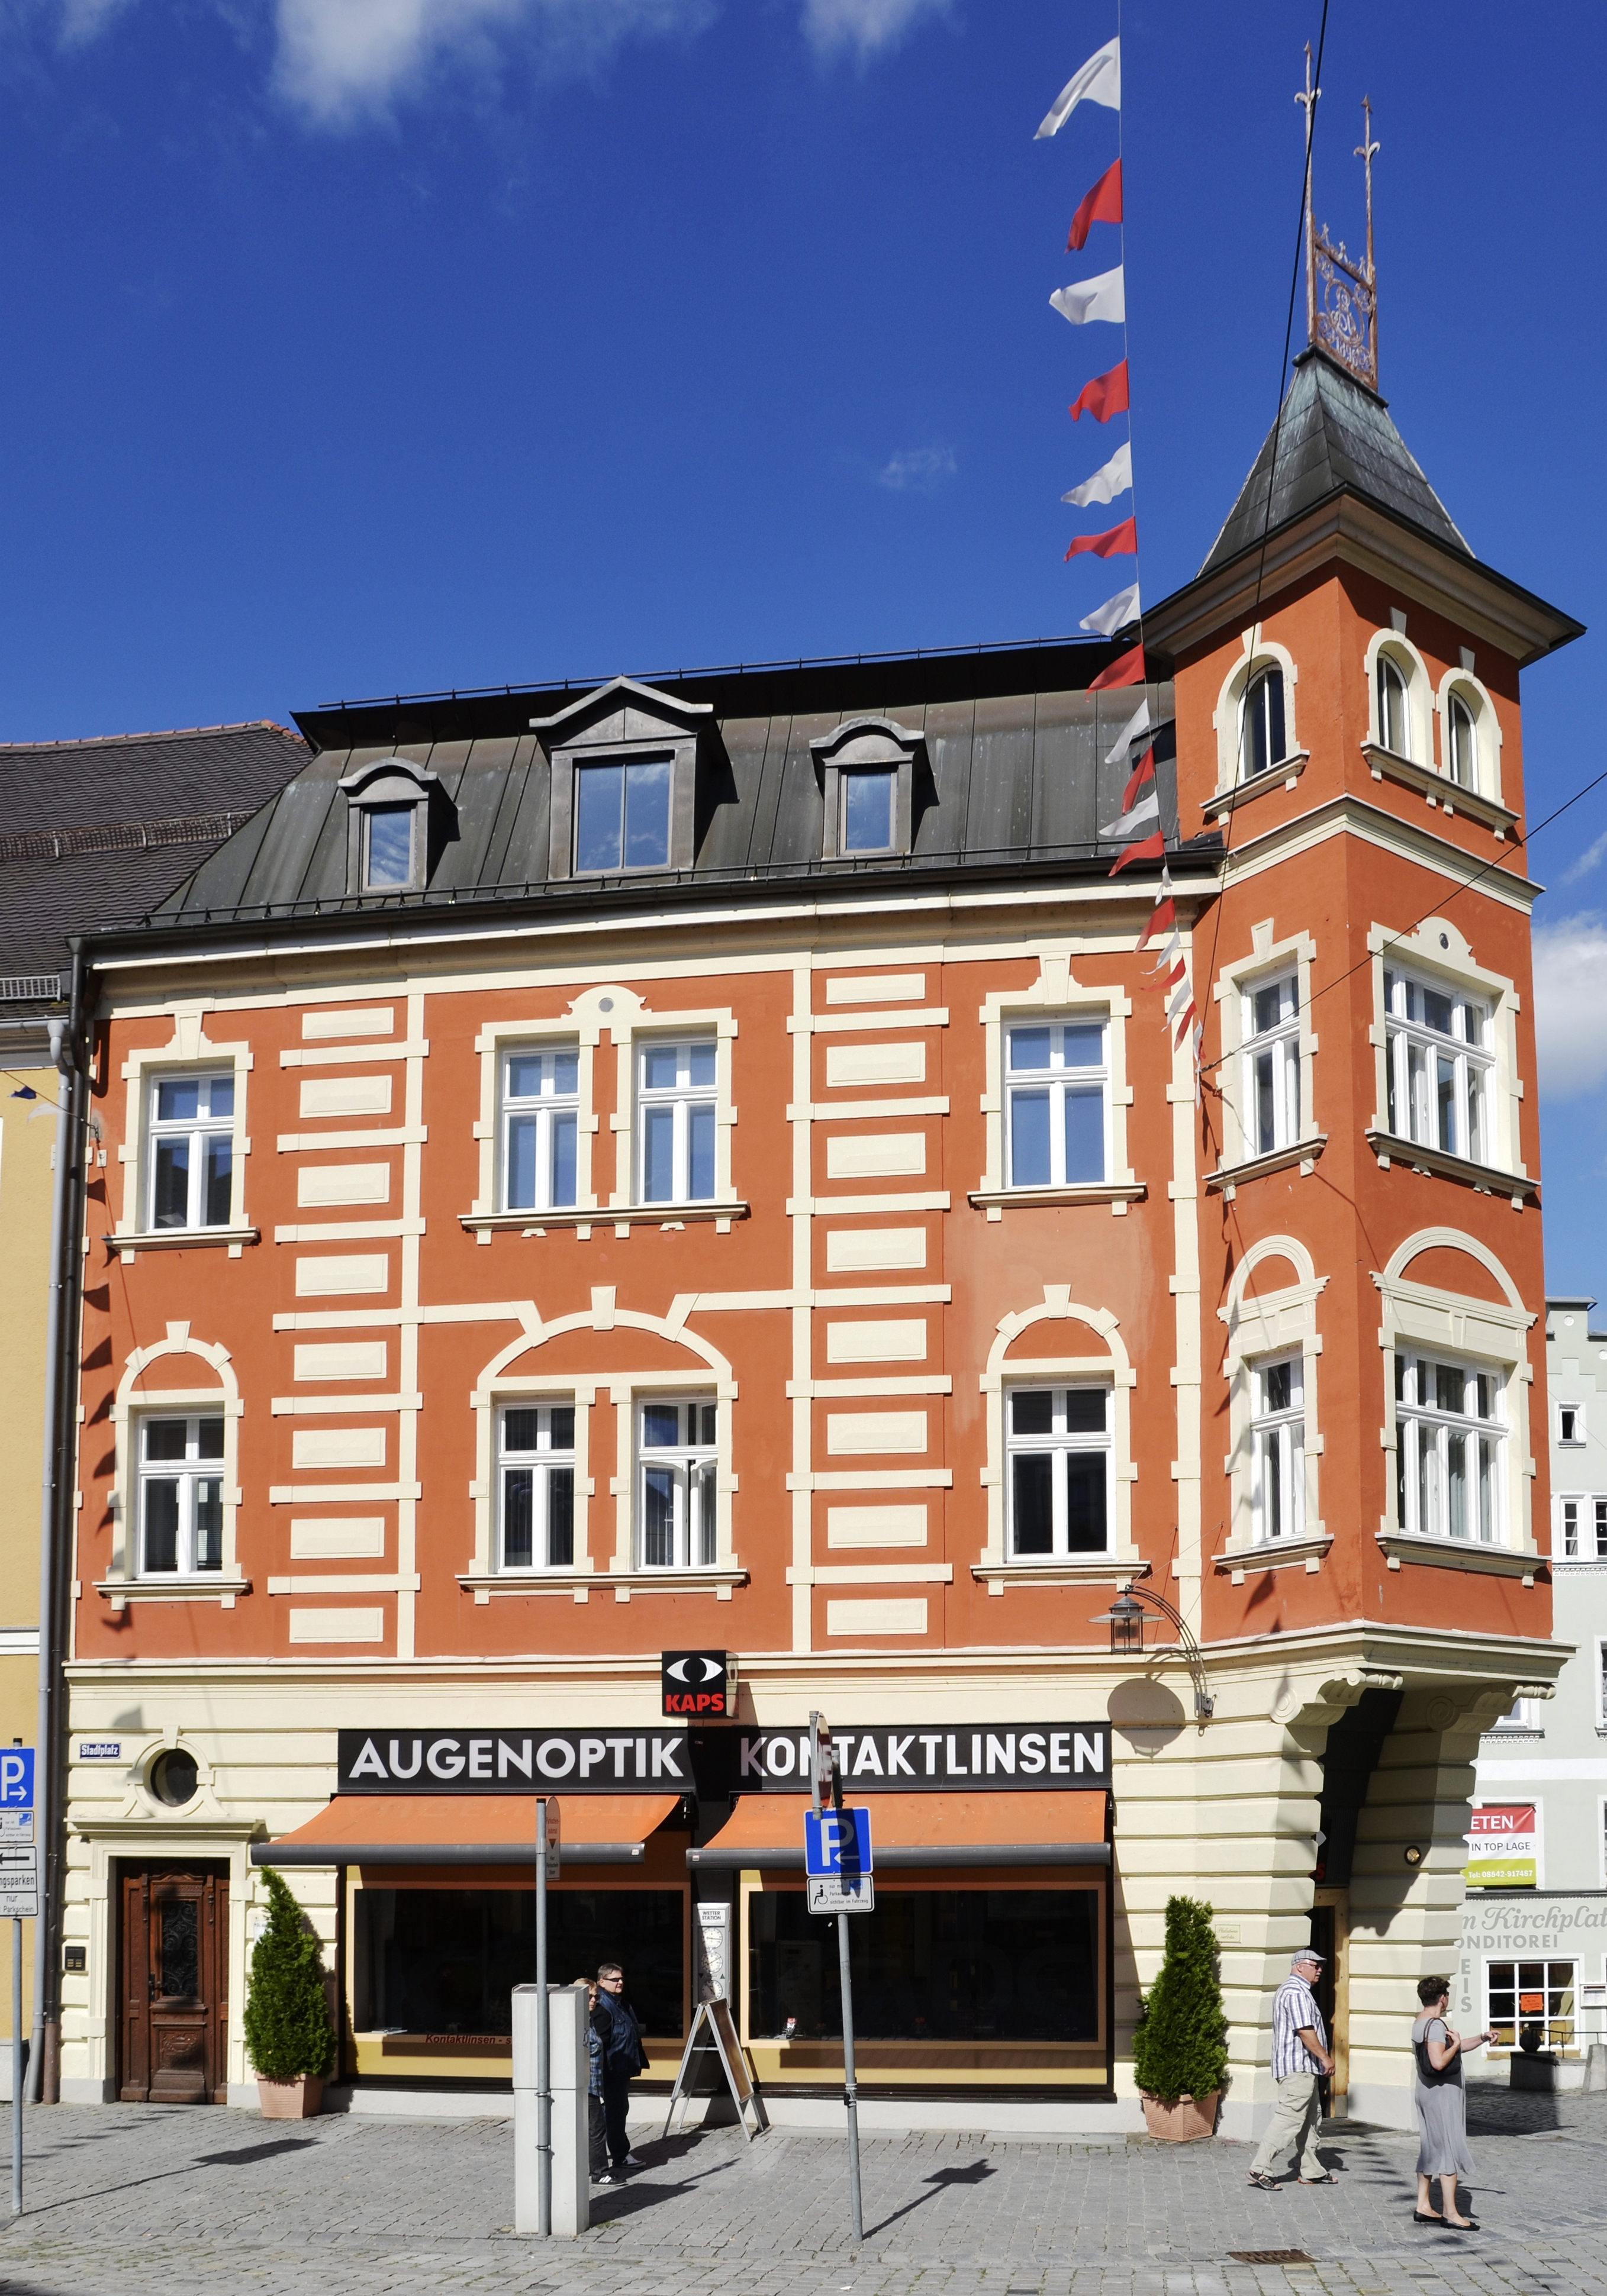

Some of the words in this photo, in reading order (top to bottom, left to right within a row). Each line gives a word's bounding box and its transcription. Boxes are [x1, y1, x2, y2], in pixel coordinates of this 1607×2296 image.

[665, 1693, 724, 1712] KAPS
[81, 1744, 118, 1757] Stadtplatz
[349, 1737, 684, 1779] AUGENOPTIK
[1, 1756, 25, 1801] P
[1470, 1815, 1513, 1830] ETEN
[820, 1818, 855, 1866] P
[1471, 1843, 1481, 1852] IN
[1484, 1842, 1503, 1851] TOP
[1506, 1842, 1531, 1850] LAGE
[1482, 1870, 1533, 1878] 08542-917487
[426, 2034, 495, 2044] Kontaktlinsen
